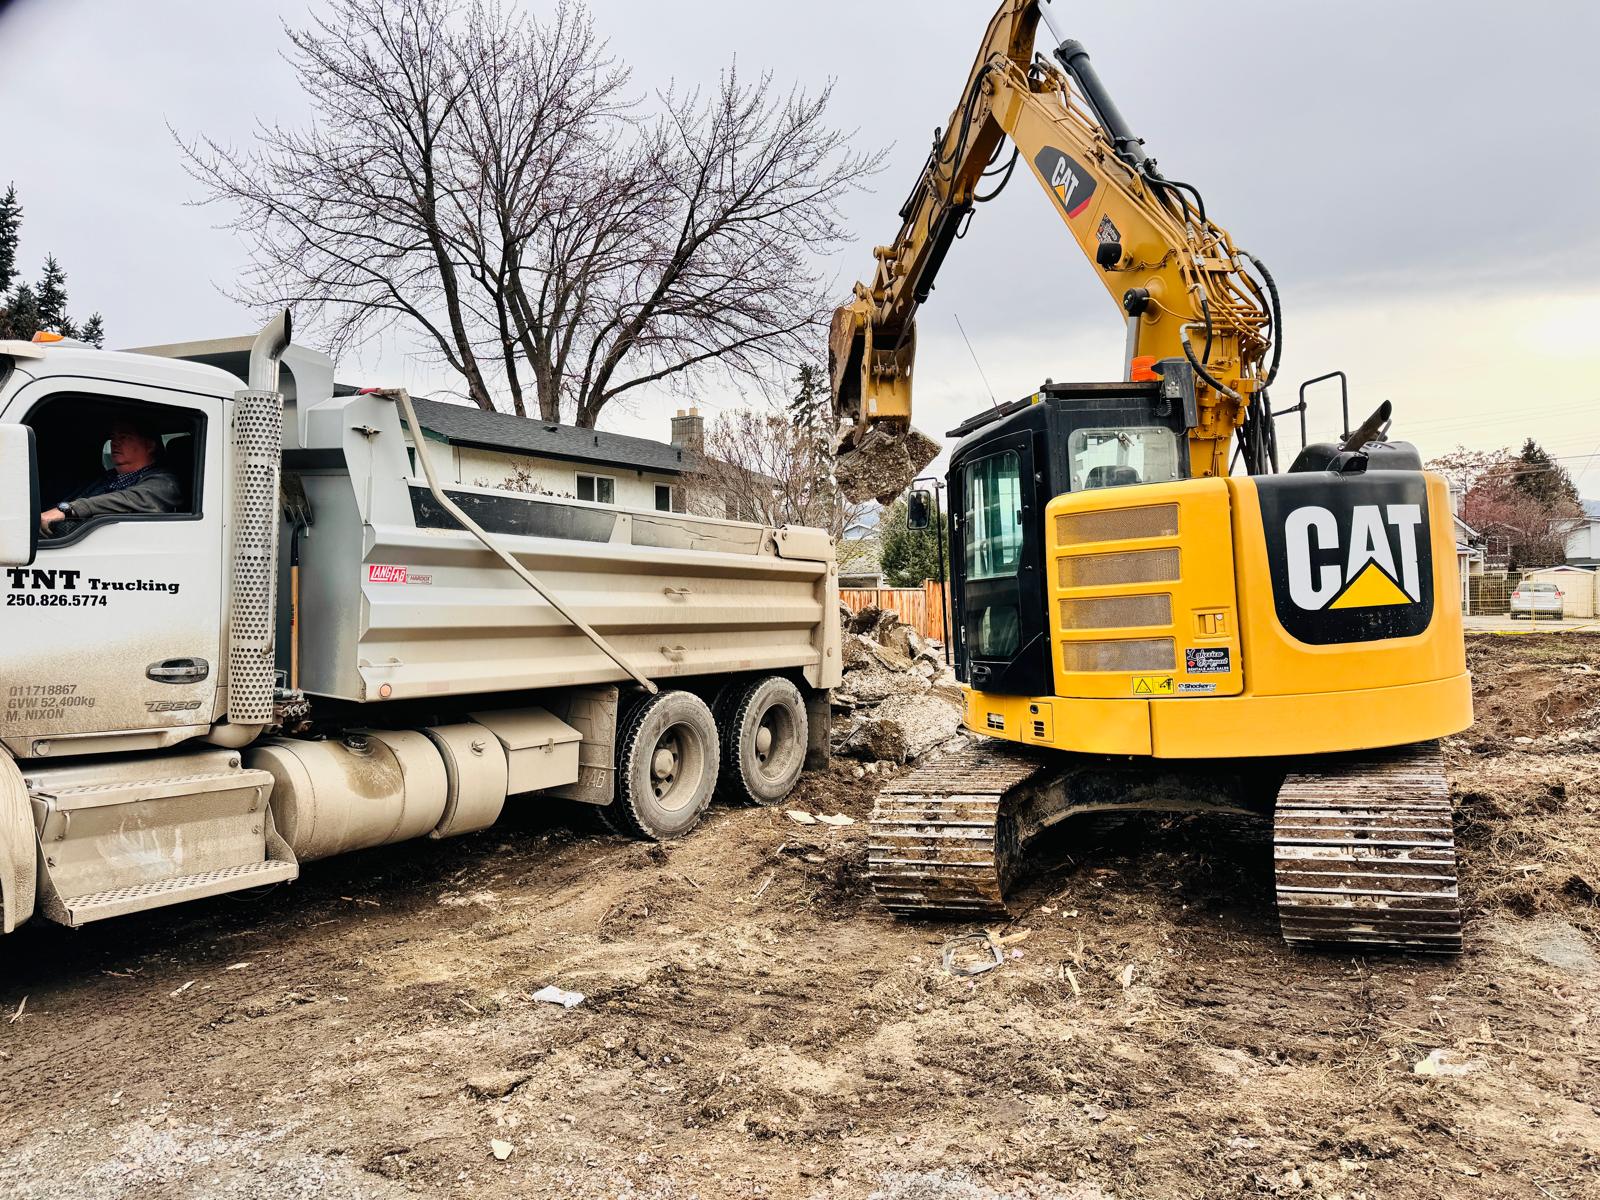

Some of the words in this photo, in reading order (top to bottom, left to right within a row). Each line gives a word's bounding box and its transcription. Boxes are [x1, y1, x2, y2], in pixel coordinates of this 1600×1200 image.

[1051, 156, 1079, 207] CAT
[1285, 504, 1422, 611] CAT
[7, 569, 80, 589] TNT
[88, 578, 180, 594] Trucking
[6, 594, 107, 606] 250.826.5774
[9, 684, 77, 697] 011718867
[8, 697, 38, 709] GVW
[40, 696, 96, 708] 52,400kg
[25, 708, 65, 721] NIXON
